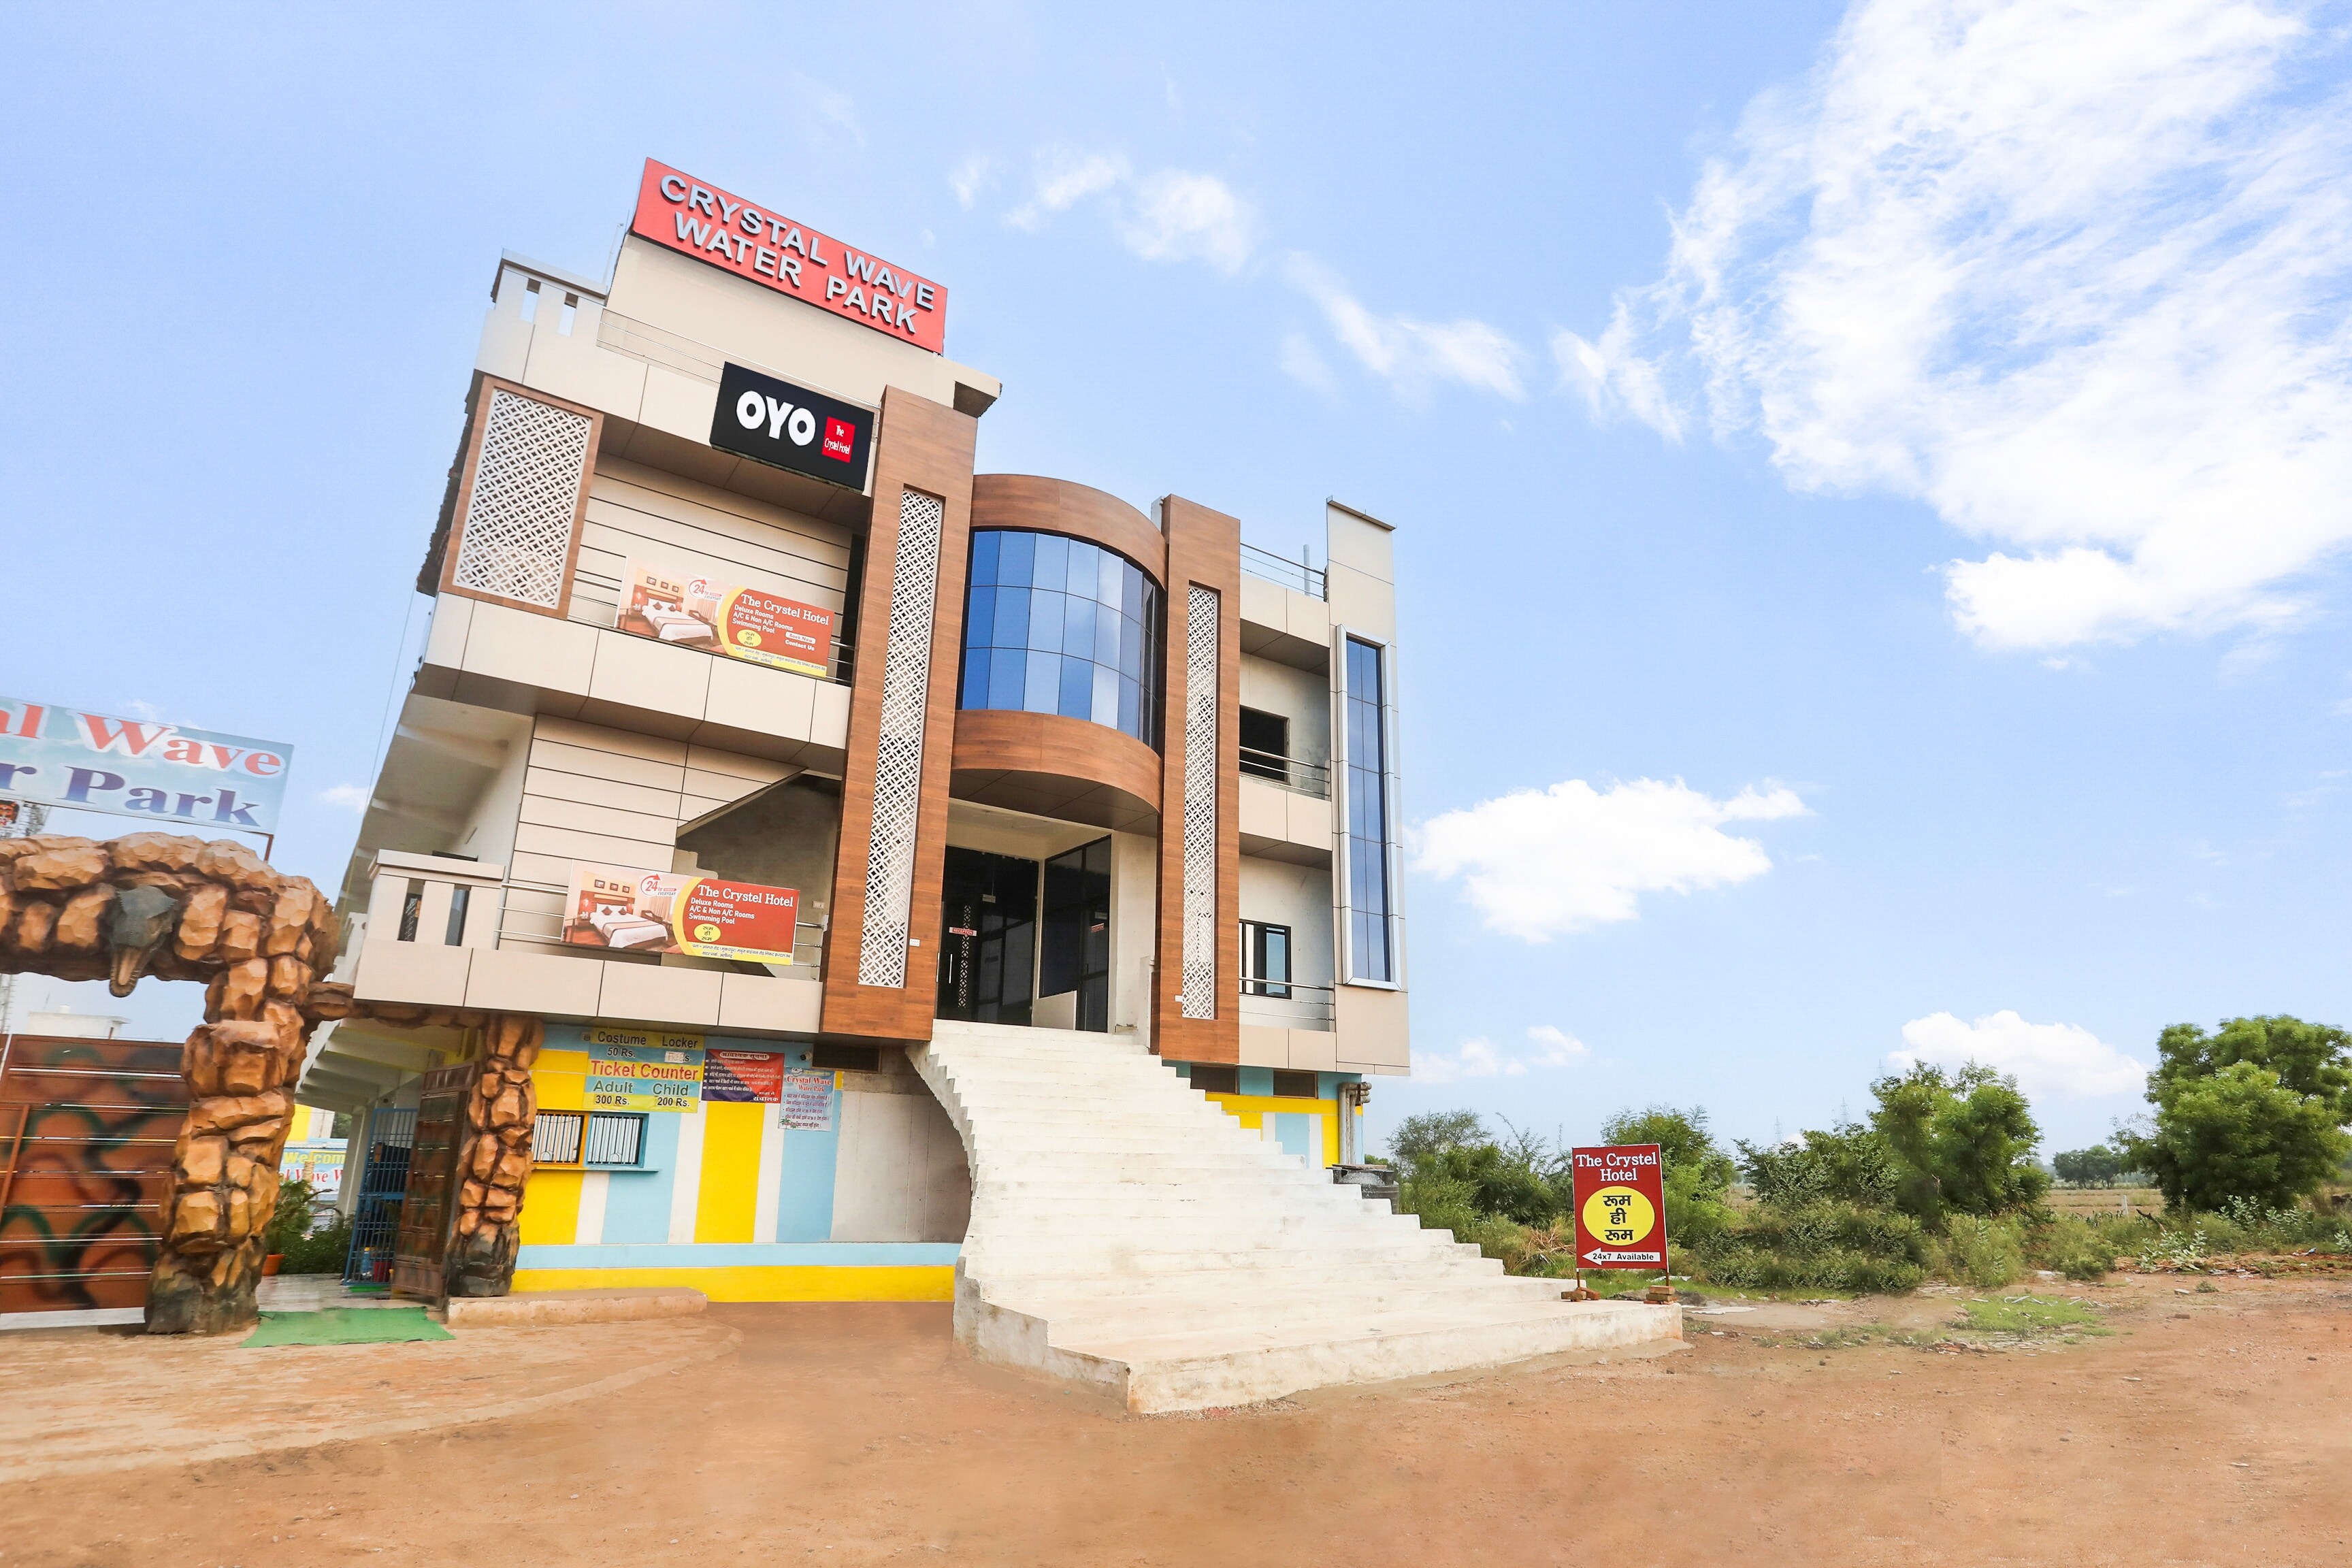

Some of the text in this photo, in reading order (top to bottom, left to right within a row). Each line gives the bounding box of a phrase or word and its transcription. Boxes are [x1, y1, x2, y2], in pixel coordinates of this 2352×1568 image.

[661, 175, 935, 310] CRYSTAL WAVE
[675, 211, 917, 333] WATER PARK
[736, 390, 816, 446] OYO
[838, 442, 851, 455] Hotel
[693, 584, 704, 594] 24
[734, 604, 774, 619] Deluxe Rooms
[741, 593, 829, 625] The Crystel Hotel
[732, 618, 761, 632] Swimming
[733, 611, 744, 619] A/C
[774, 621, 794, 632] Rooms
[785, 639, 806, 649] Contact
[78, 713, 280, 775] Wave
[56, 766, 261, 827] Park
[645, 881, 658, 891] 24
[698, 884, 793, 907] The Crystel Hotel
[691, 897, 734, 909] Deluxe Rooms
[689, 913, 720, 924] Swimming
[734, 910, 755, 919] Rooms
[598, 1031, 698, 1048] Costume Locker
[607, 1047, 636, 1058] 50 Rs.
[591, 1060, 699, 1080] Ticket Counter
[787, 1076, 811, 1084] Crystal
[593, 1080, 689, 1096] Adult Child
[595, 1095, 630, 1105] 300 Rs.
[657, 1097, 690, 1107] 200 Rs.
[1575, 1152, 1657, 1167] The Crystel
[1600, 1168, 1637, 1181] Hotel
[1603, 1195, 1631, 1207] रूम
[1610, 1207, 1627, 1224] ही
[1605, 1230, 1633, 1241] रूम
